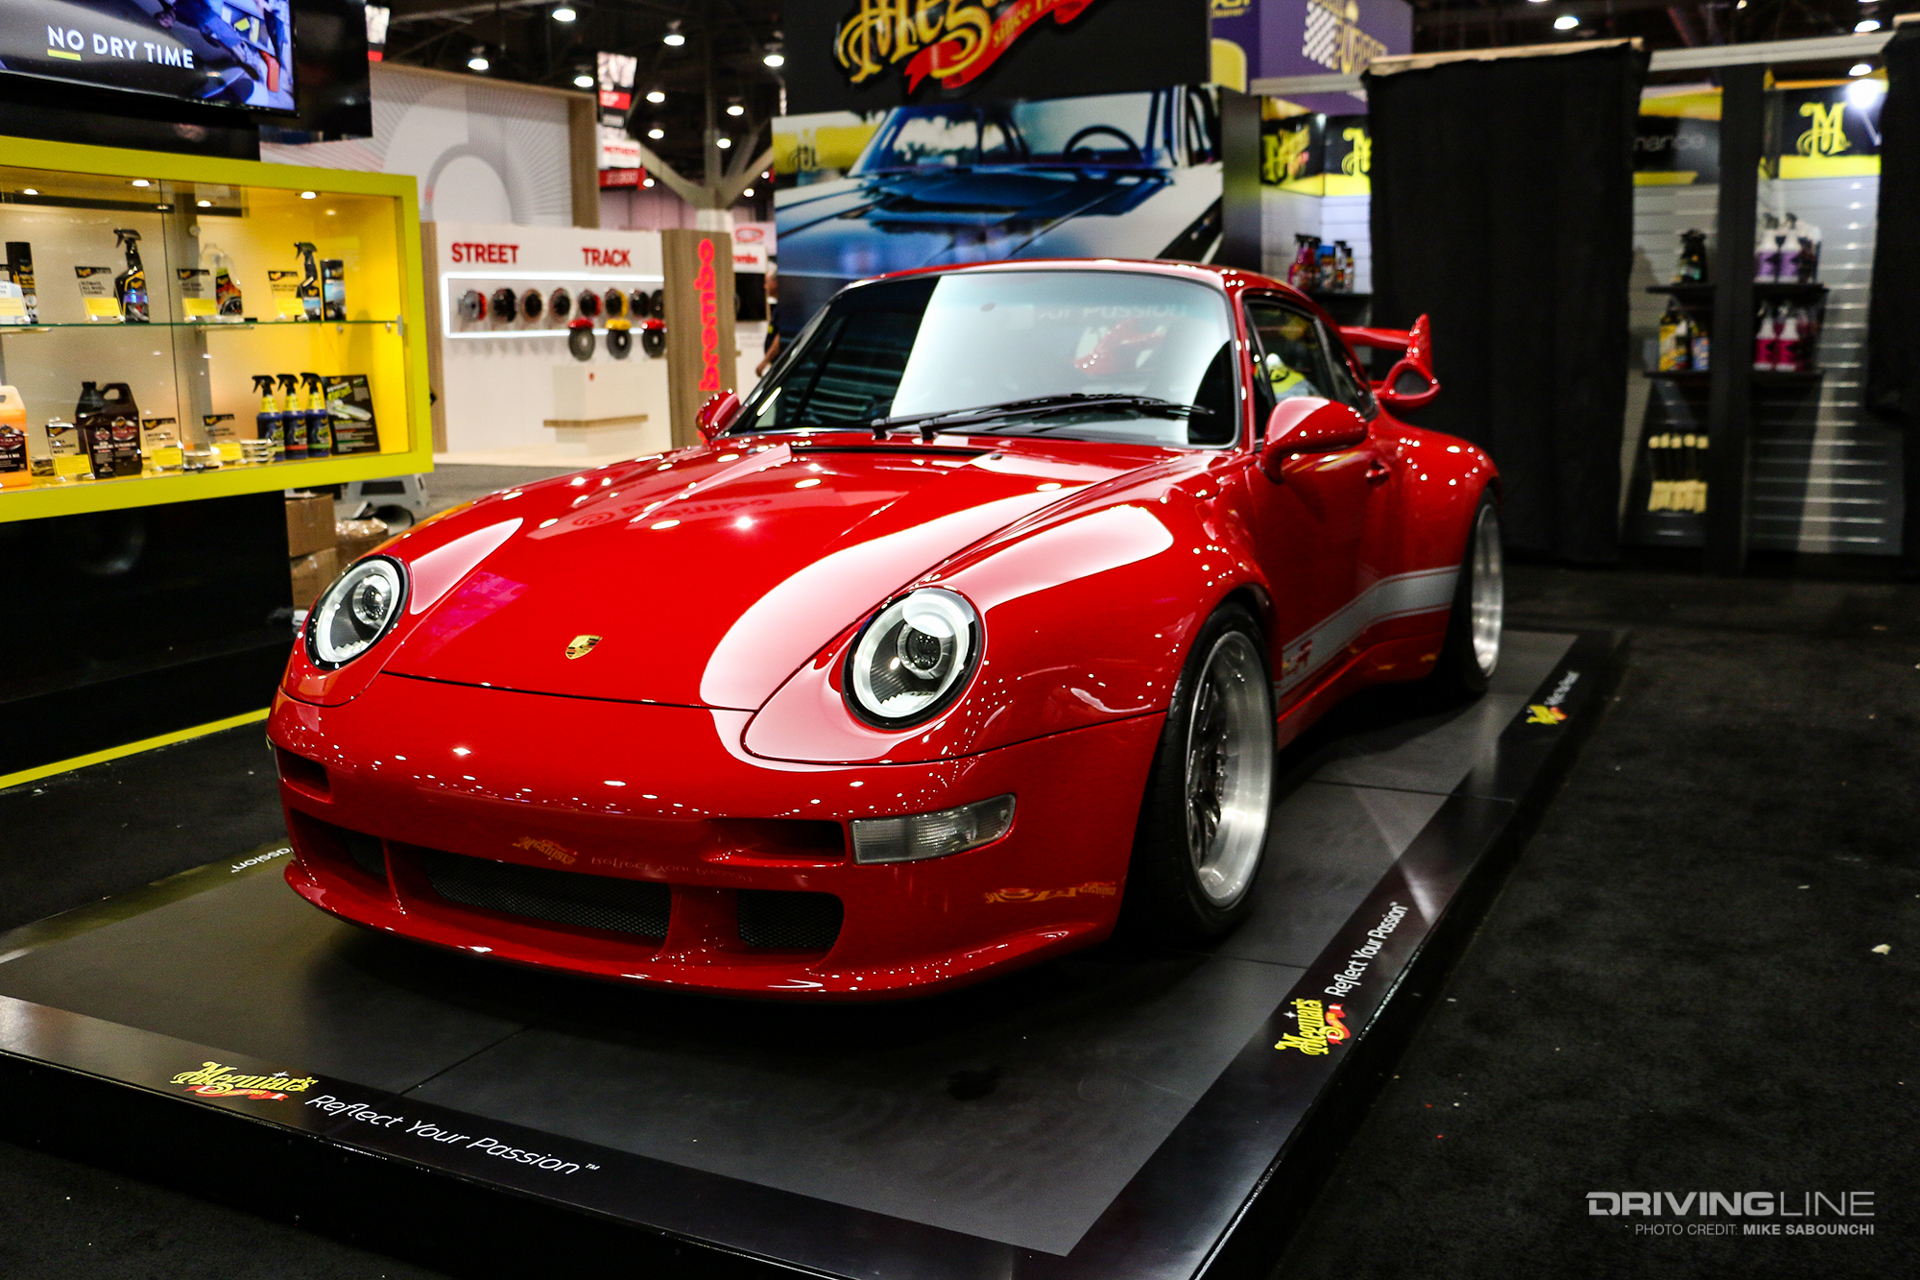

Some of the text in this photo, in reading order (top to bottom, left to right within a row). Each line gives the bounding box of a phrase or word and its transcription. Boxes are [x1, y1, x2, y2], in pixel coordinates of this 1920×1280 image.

[47, 25, 195, 69] NO DRY TIME
[451, 243, 520, 264] STREET
[582, 247, 632, 267] TRACK
[1274, 998, 1345, 1055] Meguiar's
[1324, 961, 1369, 997] Reflect
[1351, 938, 1383, 960] Your
[170, 1061, 318, 1094] Meguiar's
[305, 1094, 402, 1128] Reflect
[405, 1119, 470, 1150] Your
